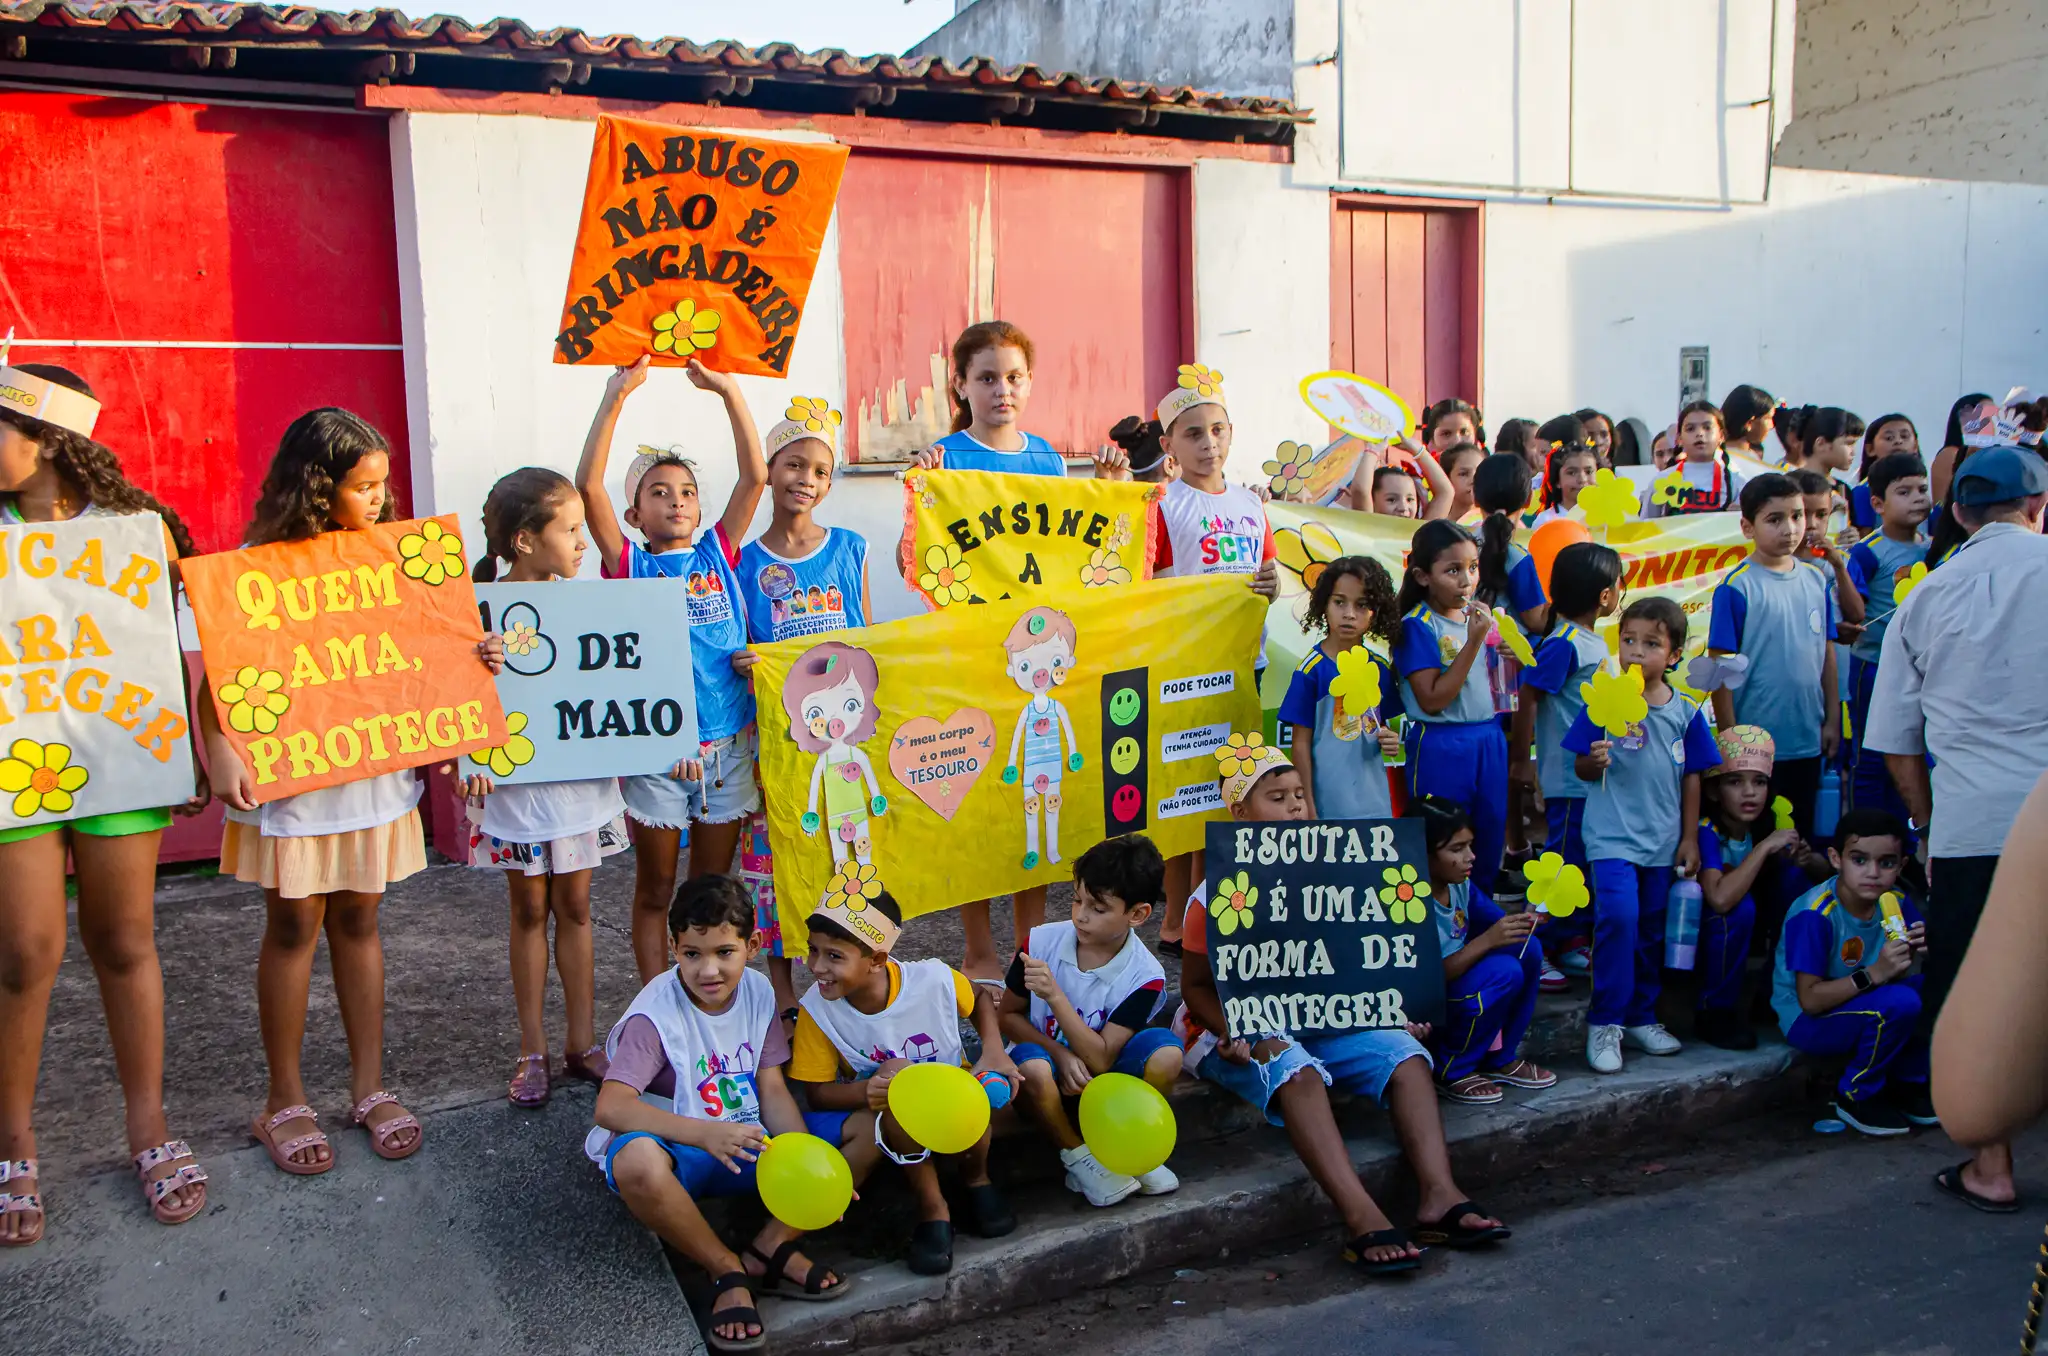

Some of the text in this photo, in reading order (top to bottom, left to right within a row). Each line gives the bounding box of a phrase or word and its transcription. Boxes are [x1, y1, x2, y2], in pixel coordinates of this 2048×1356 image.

[622, 136, 799, 196] ABUSO
[601, 186, 777, 248] NÃO É
[555, 243, 799, 372] BRINCADEIRA
[947, 501, 1109, 553] ENSINE
[0, 531, 161, 609] CAR
[1019, 553, 1042, 584] A
[1201, 537, 1258, 565] SCFV
[235, 561, 402, 630] QUEM
[779, 618, 837, 634] ADOLESCENTES
[290, 631, 423, 688] AMA,
[577, 632, 642, 671] DE
[1163, 674, 1232, 695] PODE TOCAR
[554, 698, 683, 740] MAIO
[909, 726, 974, 747] meu corpo
[1180, 728, 1212, 740] ATENÇÃO
[246, 700, 488, 785] PROTEGE
[920, 746, 966, 762] é o meu
[1164, 736, 1226, 754] (TENHA CUIDADO)
[909, 757, 978, 784] TESOURO
[1178, 783, 1214, 796] PROIBIDO
[1160, 793, 1222, 813] (NÃO PODE TOCA
[1234, 825, 1399, 865] ESCUTAR
[1269, 879, 1387, 922] É UMA
[846, 911, 885, 944] BONITO
[1216, 934, 1417, 981] FORMA DE
[1224, 988, 1408, 1039] PROTEGER
